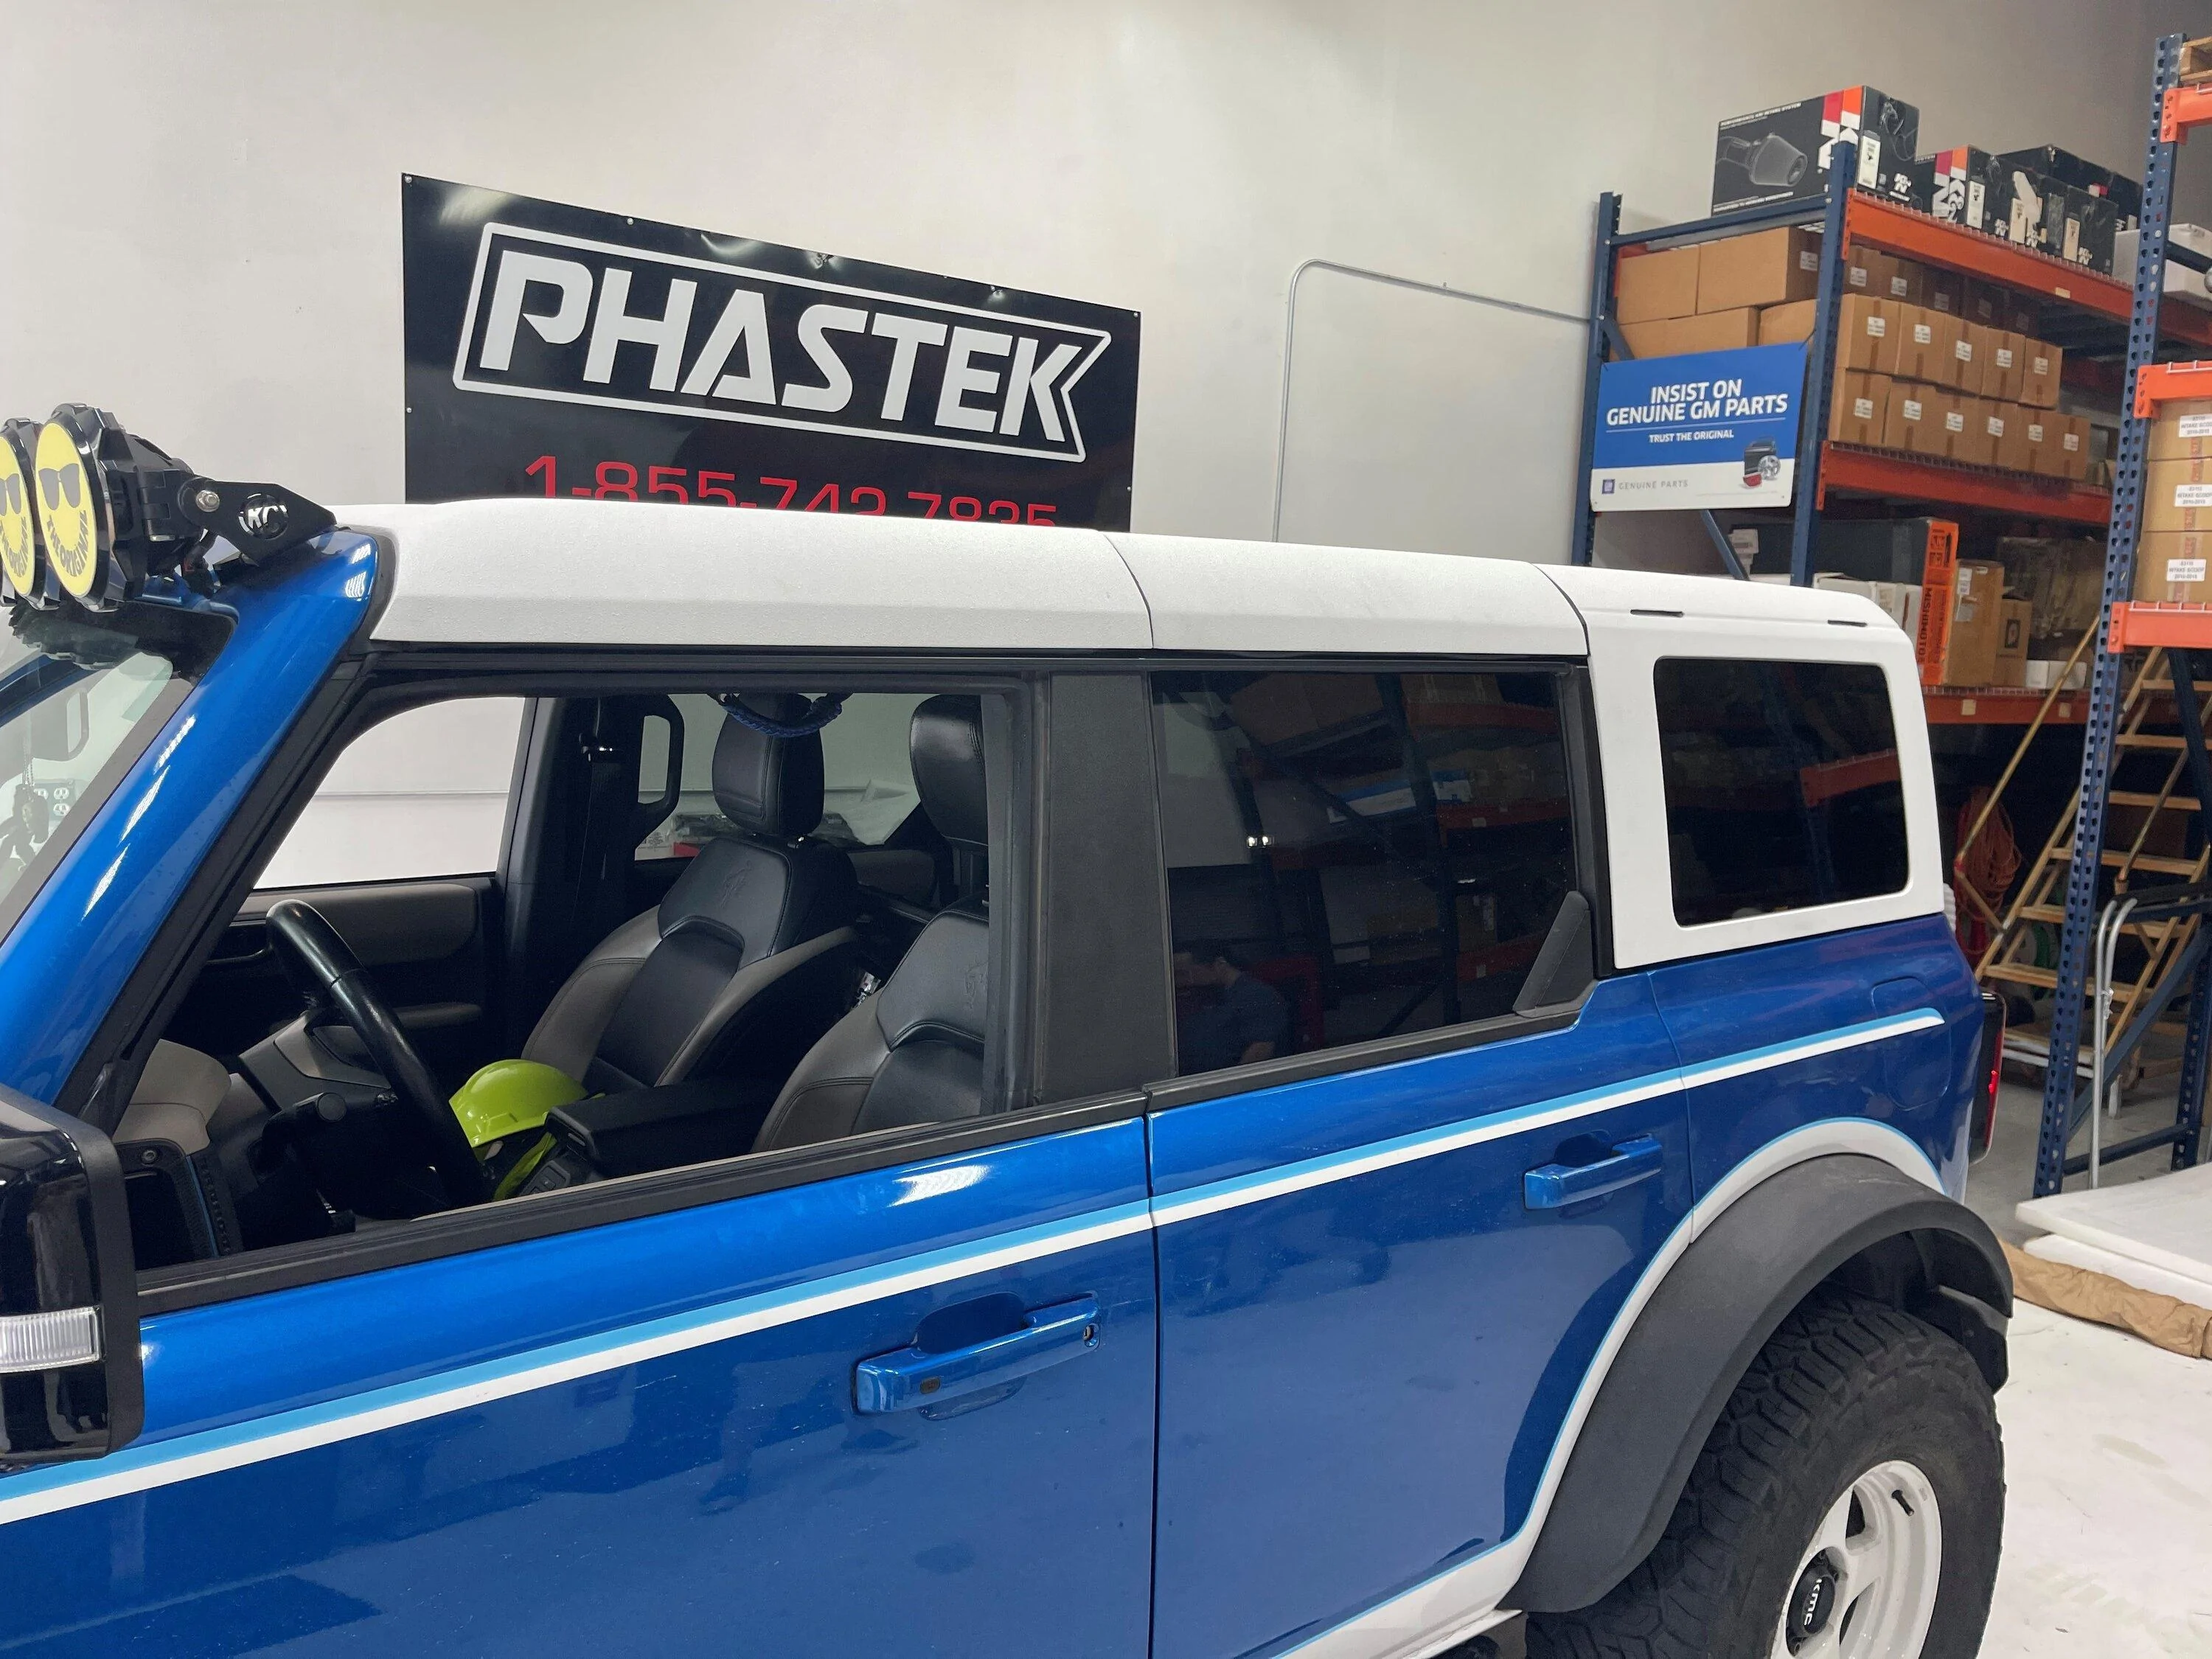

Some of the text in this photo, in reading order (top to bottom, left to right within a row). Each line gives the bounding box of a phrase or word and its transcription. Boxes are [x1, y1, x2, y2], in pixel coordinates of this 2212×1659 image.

[479, 249, 1082, 442] PHASTEK
[1651, 378, 1742, 405] INSIST ON
[1607, 393, 1789, 425] GENUINE GM PARTS
[1649, 428, 1734, 444] TRUST THE ORIGINAL
[1618, 480, 1658, 490] GENUINE
[1660, 479, 1689, 489] PARTS
[46, 509, 89, 577] THE ORIGINAL
